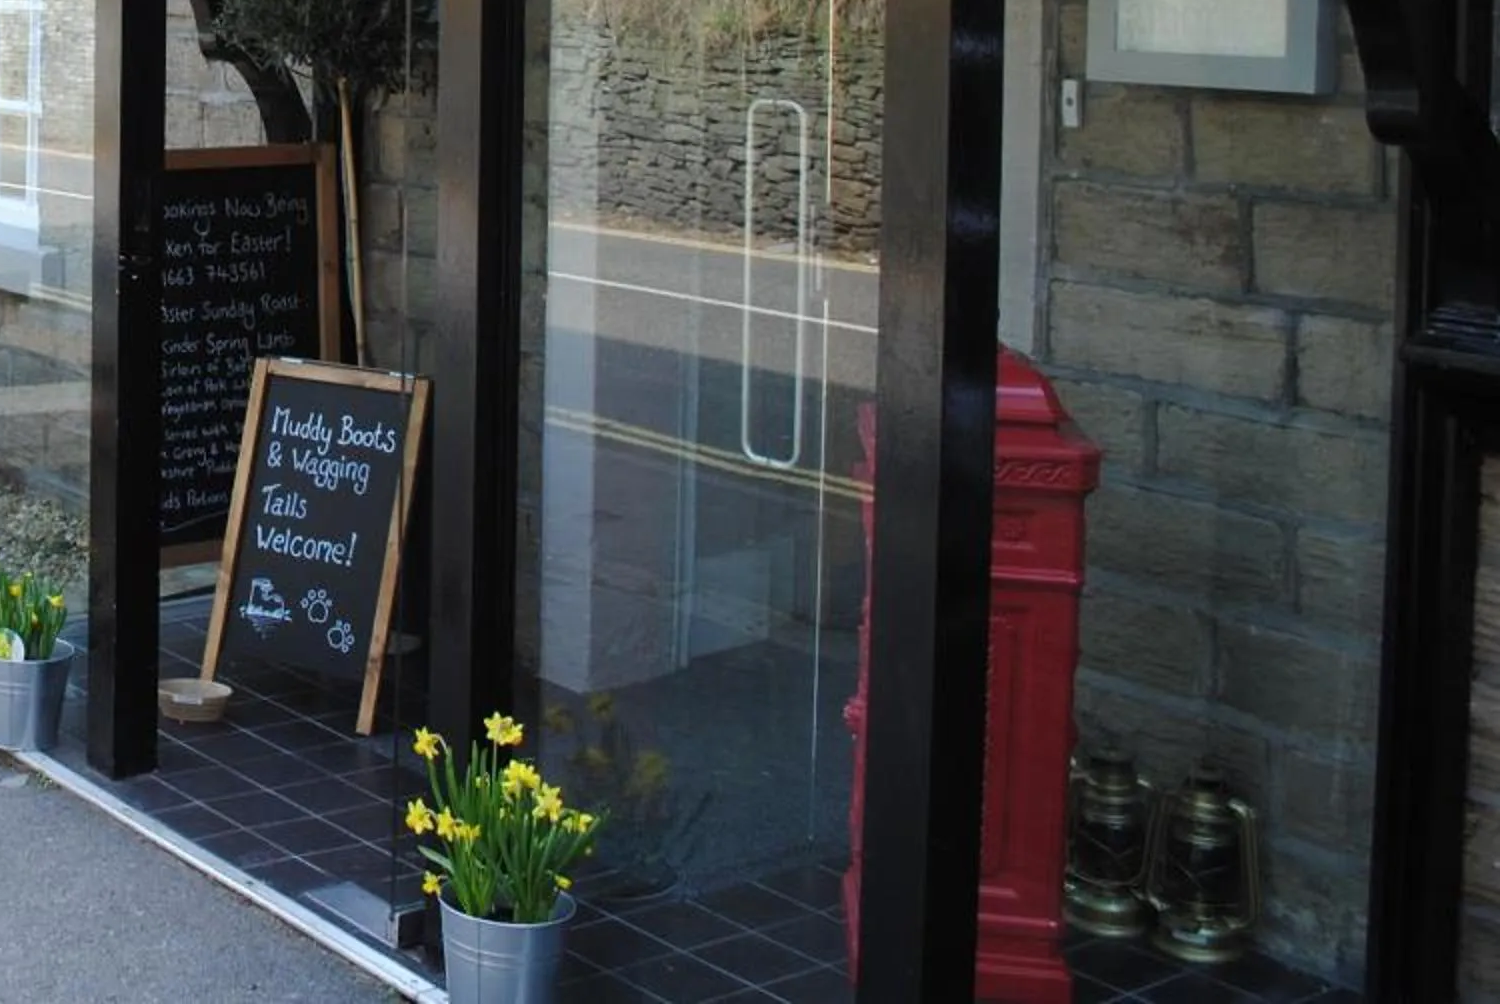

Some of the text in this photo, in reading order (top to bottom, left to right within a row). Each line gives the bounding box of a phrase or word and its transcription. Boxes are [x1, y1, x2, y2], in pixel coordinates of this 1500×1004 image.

[163, 201, 216, 235] ookings
[224, 196, 261, 218] Now
[165, 235, 193, 257] ken
[230, 224, 292, 254] Easter!
[162, 259, 266, 286] 1663 743561
[201, 296, 256, 330] Sunday
[205, 331, 250, 359] Spring
[257, 328, 295, 349] Lamb
[270, 405, 333, 455] Muddy
[338, 414, 396, 454] Boots
[267, 441, 281, 468] &
[292, 448, 371, 495] Wagging
[261, 483, 307, 520] Tails
[255, 524, 357, 567] Welcome!
